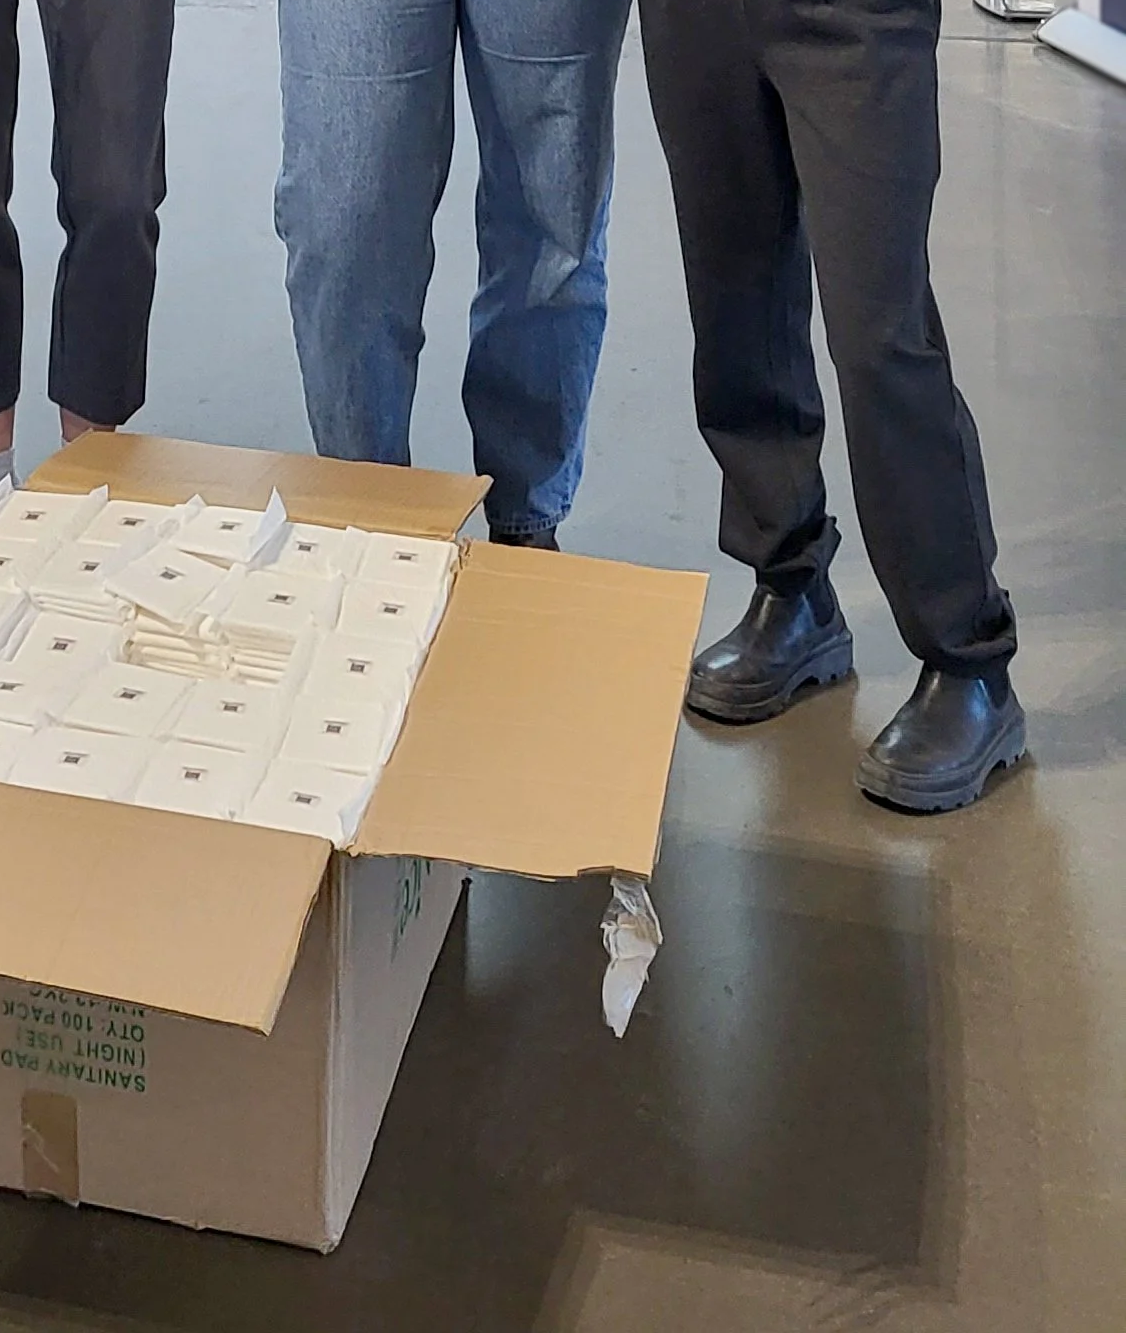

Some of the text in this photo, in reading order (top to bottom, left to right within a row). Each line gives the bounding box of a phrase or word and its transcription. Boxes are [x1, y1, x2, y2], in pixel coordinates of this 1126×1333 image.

[62, 1010, 92, 1031] 100
[1, 1048, 146, 1093] SANITARY PAD
